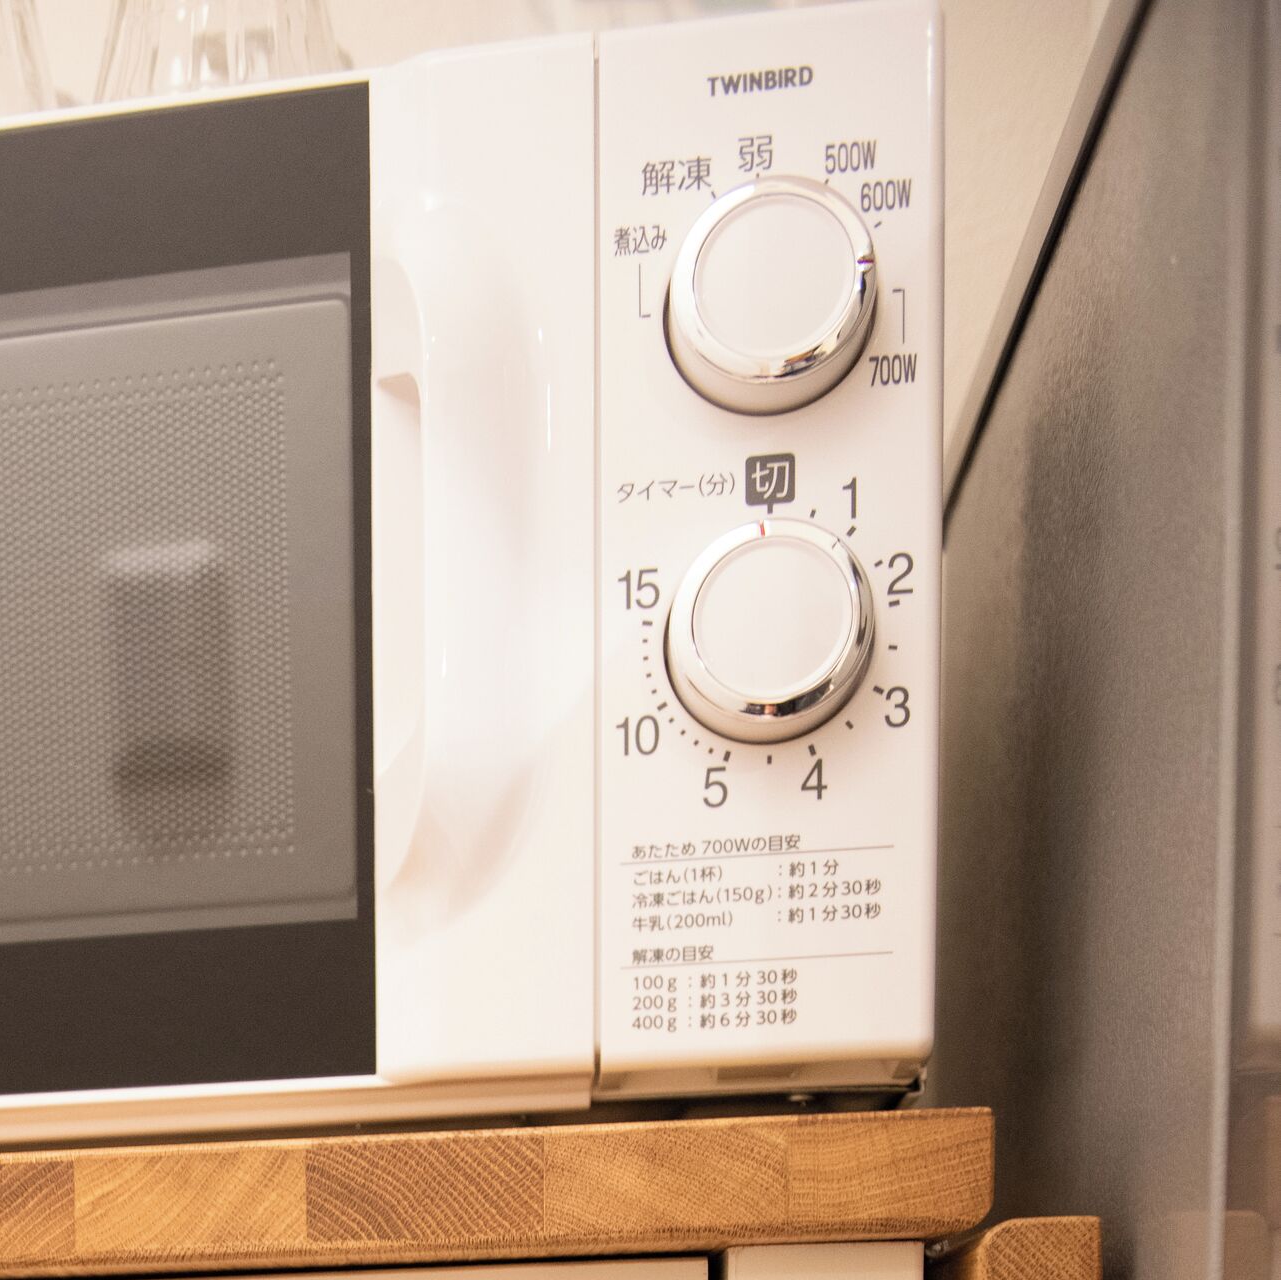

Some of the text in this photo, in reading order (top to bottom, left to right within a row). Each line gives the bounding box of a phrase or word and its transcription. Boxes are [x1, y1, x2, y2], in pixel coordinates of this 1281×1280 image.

[707, 66, 813, 97] TWINBIRD
[738, 135, 773, 172] 弱
[825, 140, 876, 174] 500W
[641, 156, 712, 196] 解凍
[861, 179, 912, 212] 600W
[614, 225, 667, 256] 煮込み
[869, 354, 917, 387] 700W
[751, 461, 789, 499] 切
[842, 477, 858, 519] 1
[617, 568, 661, 610] 15
[887, 552, 914, 596] 2
[884, 687, 911, 728] 3
[616, 715, 660, 757] 10
[703, 766, 728, 808] 5
[801, 758, 828, 800] 4
[632, 945, 714, 964] 解凍の目安
